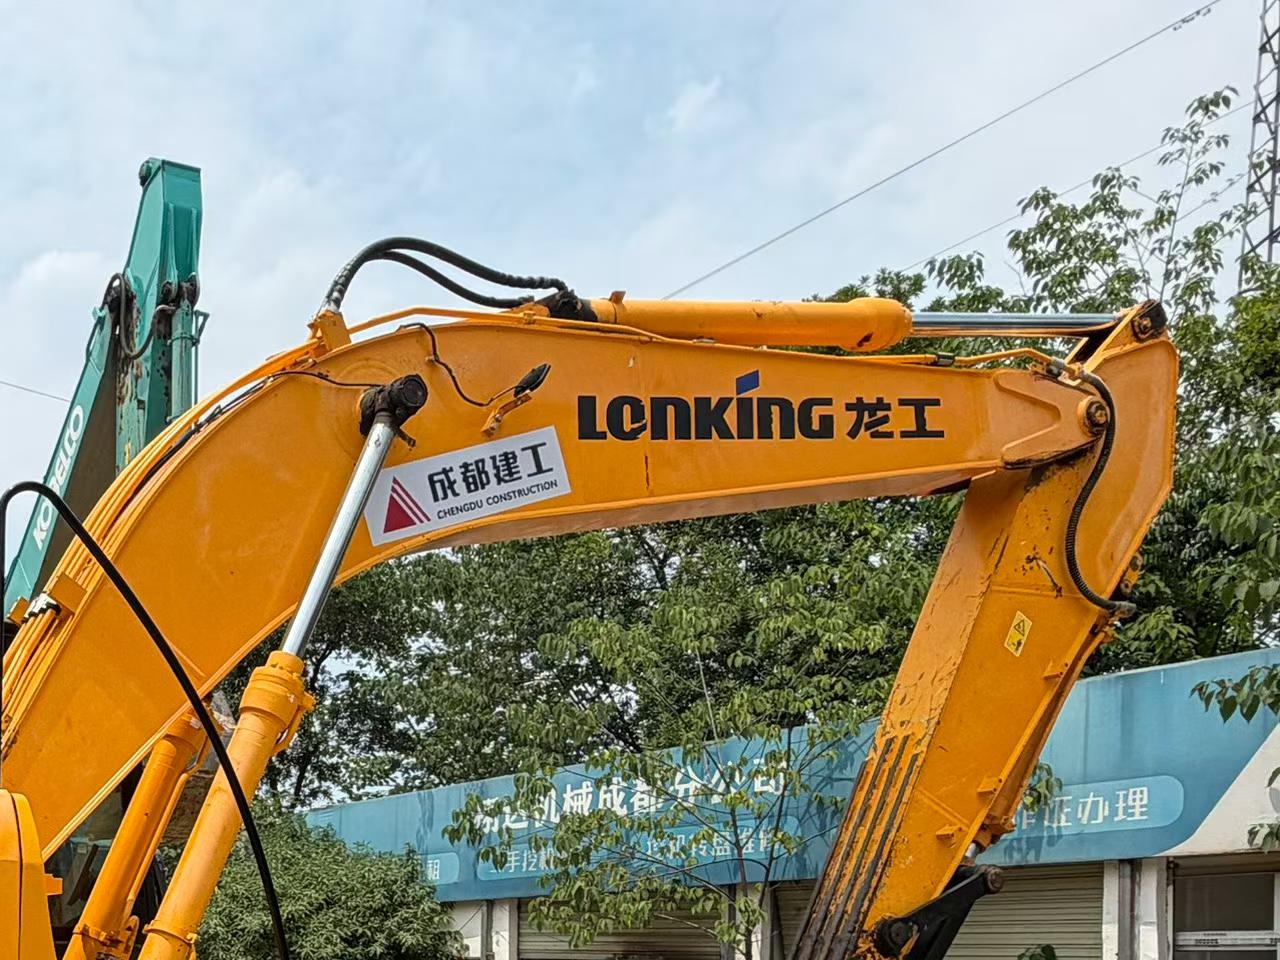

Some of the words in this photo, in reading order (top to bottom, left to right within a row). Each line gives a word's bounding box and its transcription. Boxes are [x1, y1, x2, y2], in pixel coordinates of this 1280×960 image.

[845, 397, 945, 439] 龙工
[427, 442, 554, 503] 成都建工
[436, 498, 484, 520] CHENGDU
[486, 479, 559, 506] CONSTRUCTION
